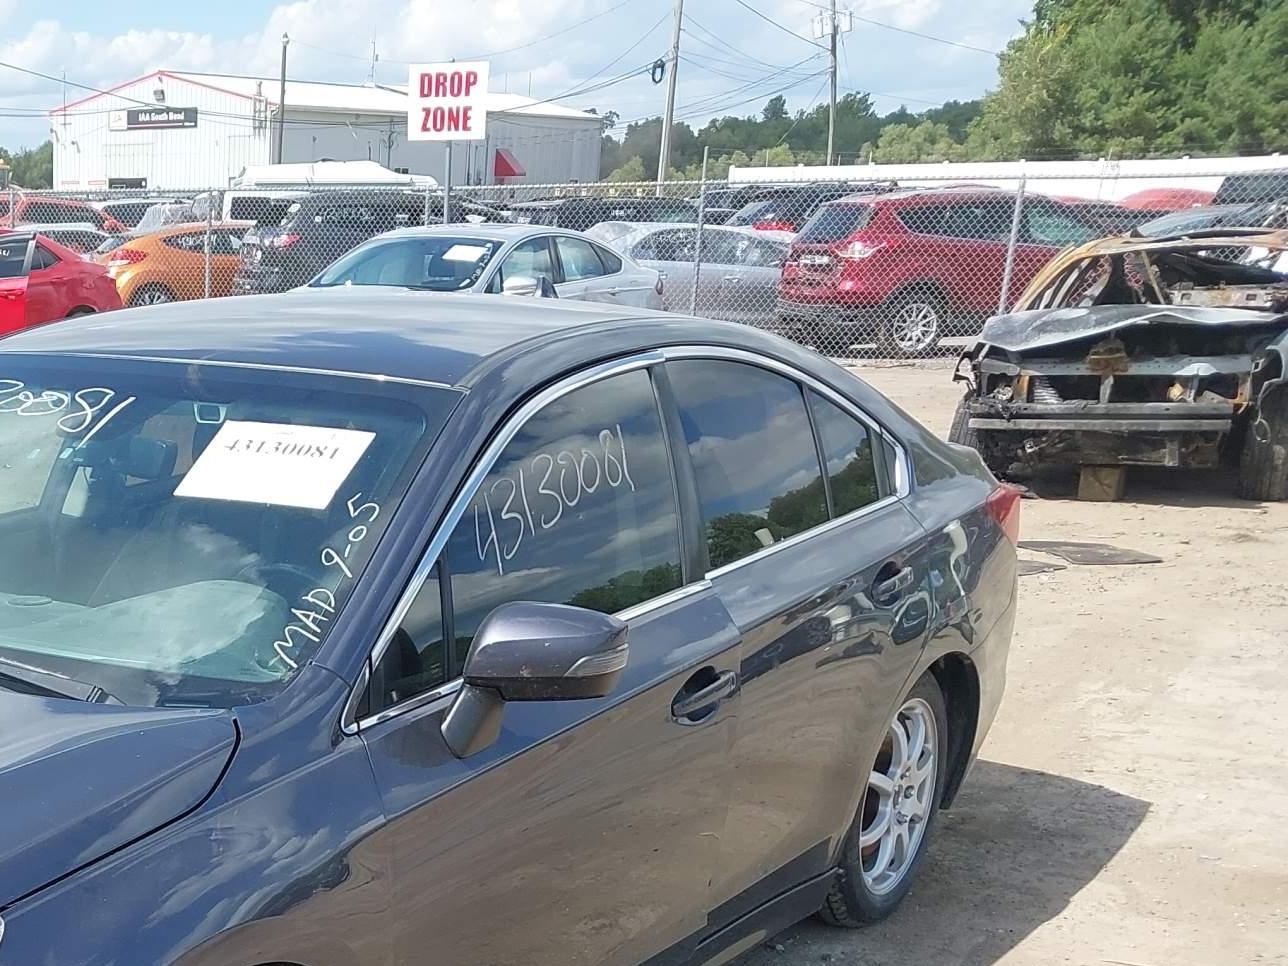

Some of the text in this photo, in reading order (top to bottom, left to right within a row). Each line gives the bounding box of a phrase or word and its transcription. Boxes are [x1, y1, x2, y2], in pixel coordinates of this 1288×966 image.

[419, 71, 478, 98] DROP
[421, 106, 473, 132] ZONE
[224, 438, 340, 460] 43130081
[474, 423, 636, 576] 43130081
[273, 491, 381, 669] MAD 9-05
